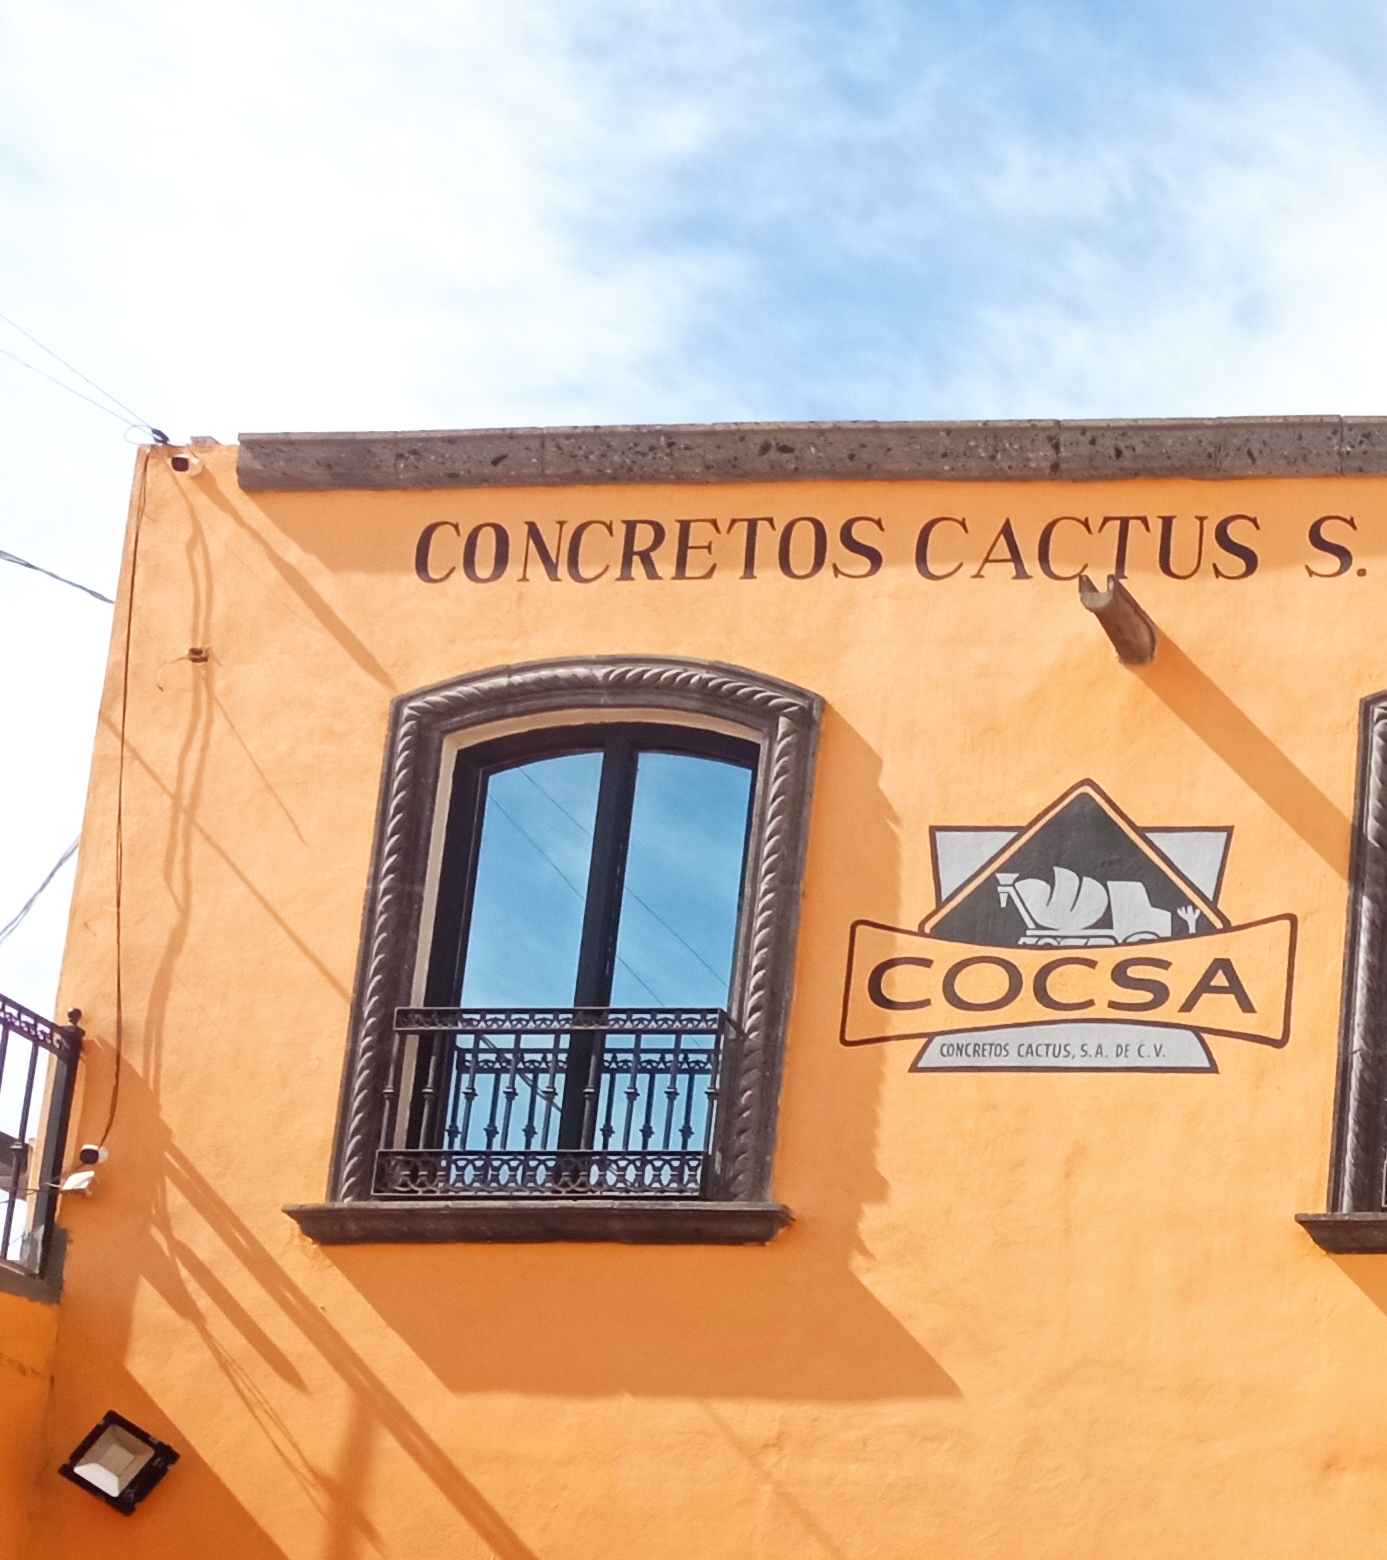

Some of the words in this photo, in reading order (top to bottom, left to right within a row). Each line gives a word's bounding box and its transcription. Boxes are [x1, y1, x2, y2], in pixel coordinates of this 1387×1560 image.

[413, 515, 886, 584] CONCRETOS
[914, 513, 1262, 581] CACTUS
[866, 953, 1258, 1015] COCSA
[939, 1042, 1010, 1059] CONCRETOS
[1017, 1042, 1076, 1060] CACTUS,
[1115, 1043, 1131, 1059] DE
